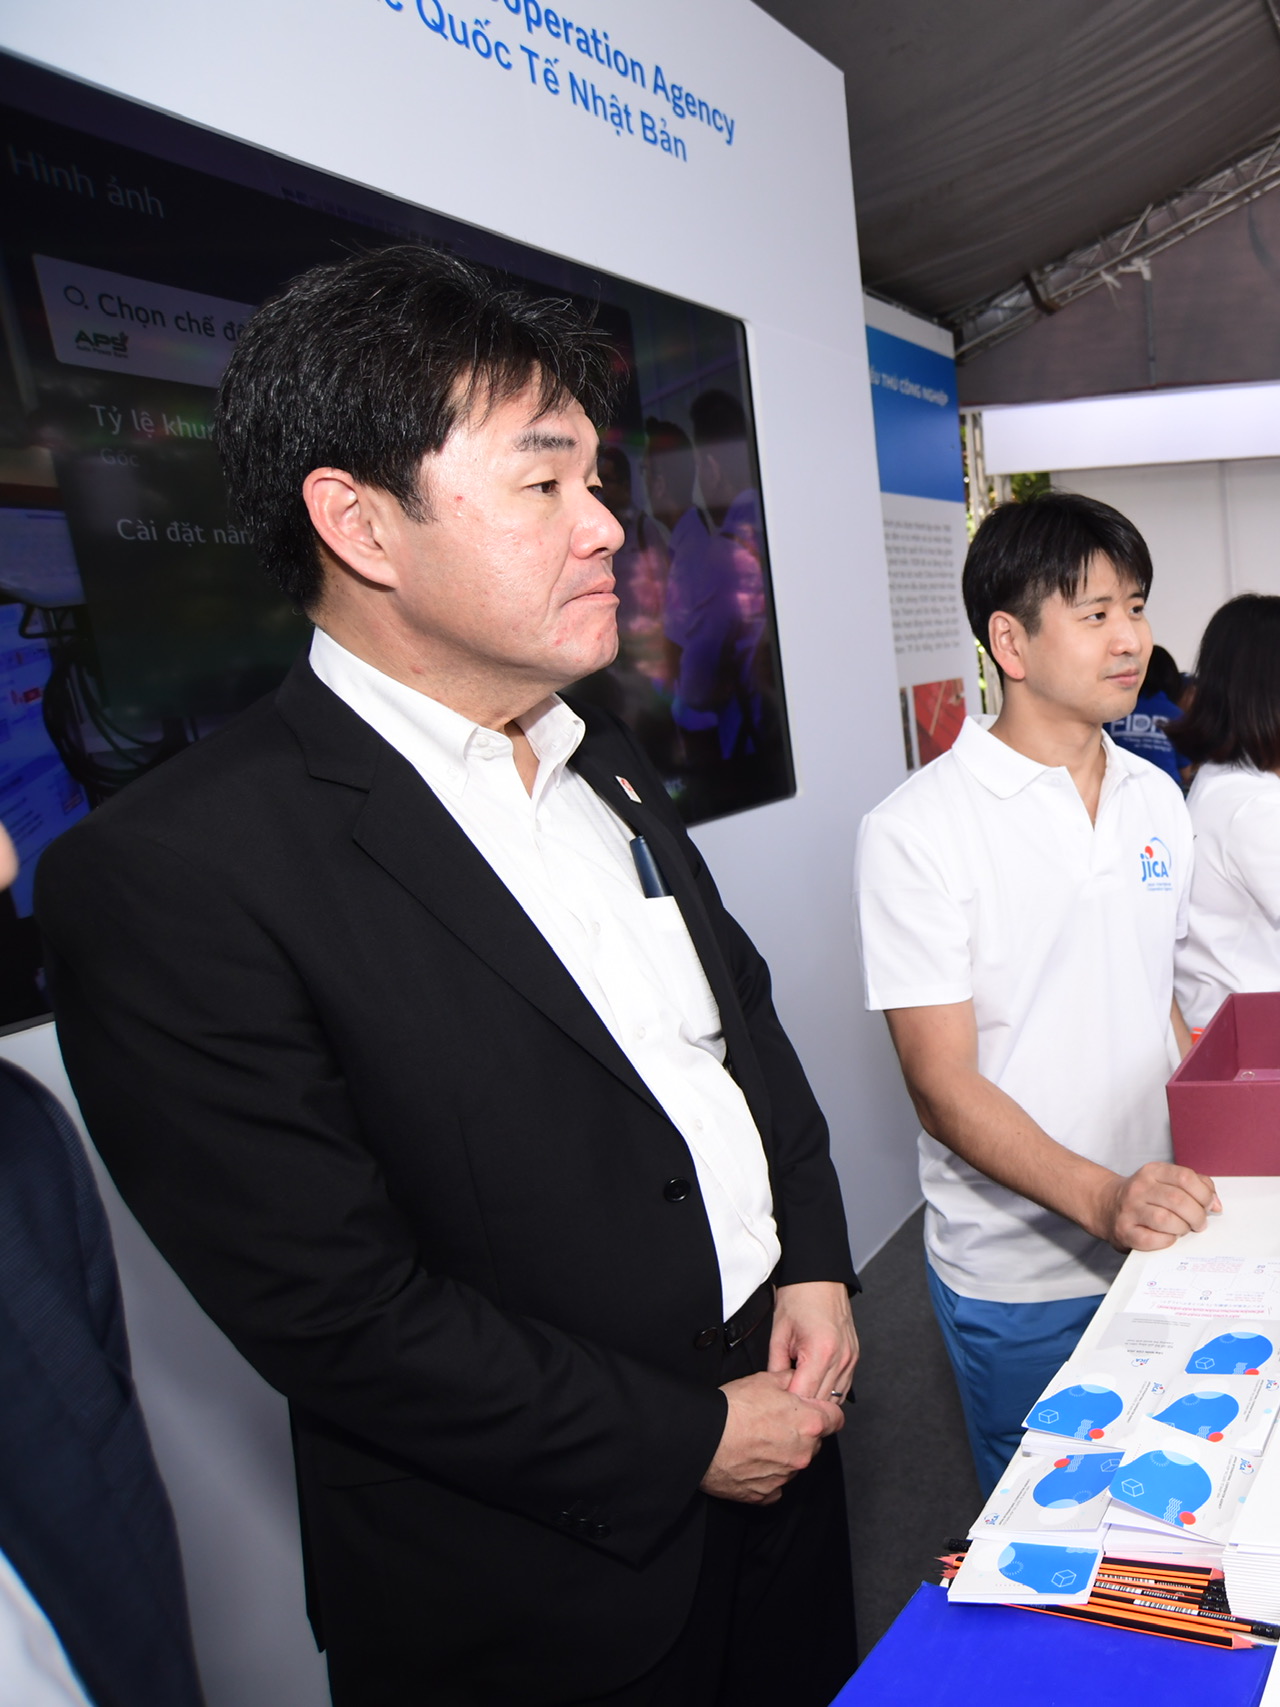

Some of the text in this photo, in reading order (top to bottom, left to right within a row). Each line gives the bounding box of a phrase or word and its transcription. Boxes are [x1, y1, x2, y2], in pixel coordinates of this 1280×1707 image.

[416, 0, 688, 162] Quốc Tế Nhật Bản
[653, 65, 735, 145] Agency
[8, 145, 165, 219] Hình ảnh
[98, 293, 166, 329] Chọn
[174, 311, 216, 338] chế
[89, 404, 122, 435] Tỷ
[132, 410, 154, 438] lệ
[116, 518, 158, 543] Cài
[167, 518, 206, 547] đặt
